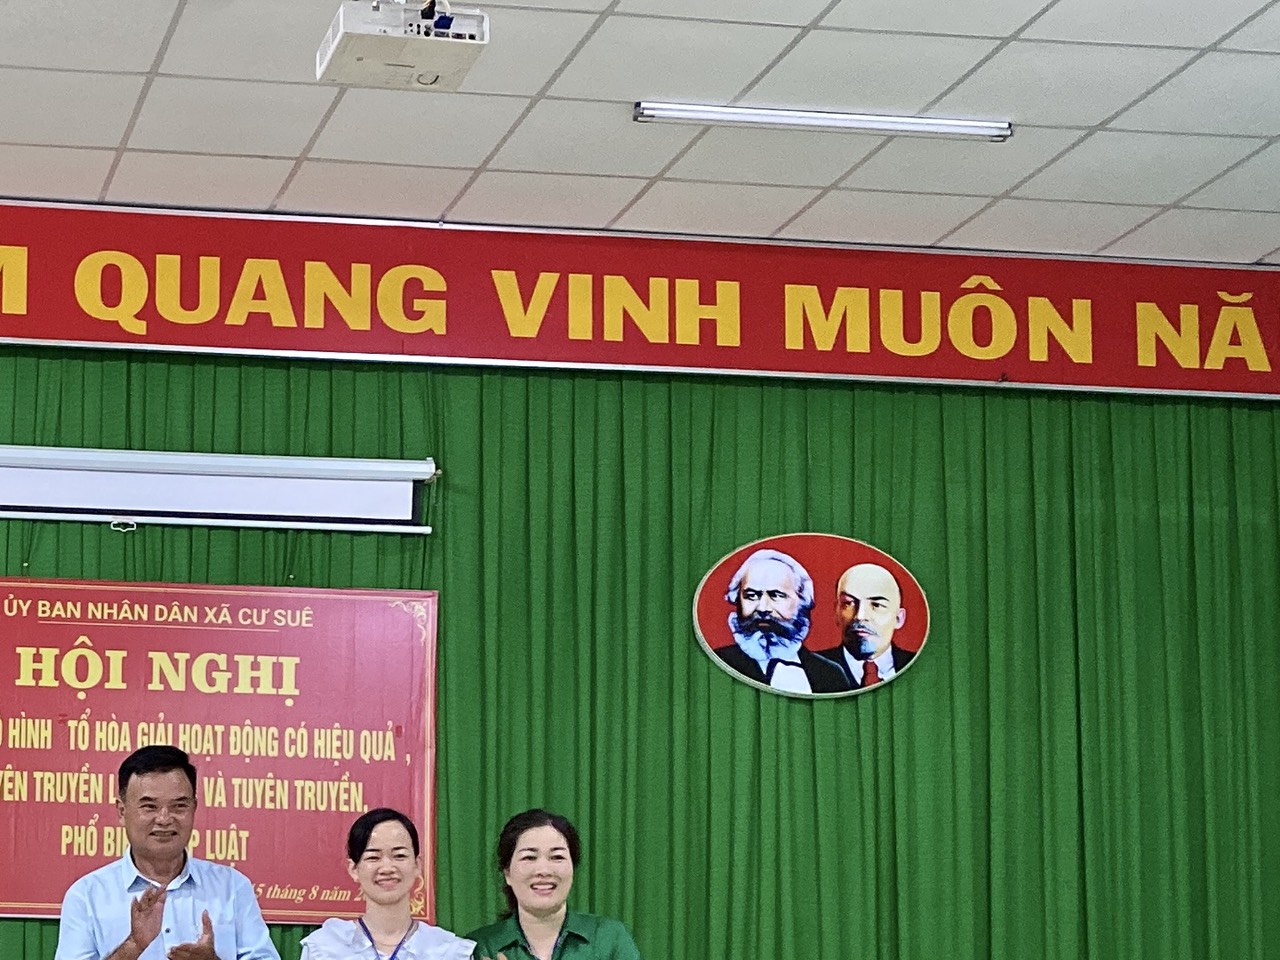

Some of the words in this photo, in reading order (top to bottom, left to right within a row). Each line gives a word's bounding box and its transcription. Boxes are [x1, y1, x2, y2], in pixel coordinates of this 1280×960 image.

[74, 251, 447, 335] QUANG
[491, 270, 740, 346] VINH
[785, 275, 1092, 363] MUÔN
[4, 594, 31, 616] ỦY
[38, 600, 81, 619] BAN
[88, 601, 148, 621] NHÂN
[155, 602, 197, 622] DÂN
[204, 604, 232, 624] XÃ
[238, 608, 271, 625] CƯ
[274, 607, 313, 627] SUÊ
[15, 636, 127, 699] HỘI
[148, 652, 300, 706] NGHỊ
[9, 712, 51, 749] HÌNH
[68, 708, 90, 750] TỔ
[95, 713, 131, 751] HÒA
[137, 712, 173, 748] GIẢI
[179, 723, 224, 761] HOẠT
[230, 720, 278, 762] ĐỘNG
[285, 722, 307, 758] CÓ
[314, 723, 354, 765] HIỆU
[33, 763, 103, 803] TRUYỀN
[204, 771, 226, 807] VÀ
[232, 773, 288, 809] TUYÊN
[61, 814, 99, 856] PHỔ
[206, 824, 249, 867] LUẬT
[266, 884, 306, 904] tháng
[309, 885, 319, 900] 8
[320, 886, 351, 902] năm
